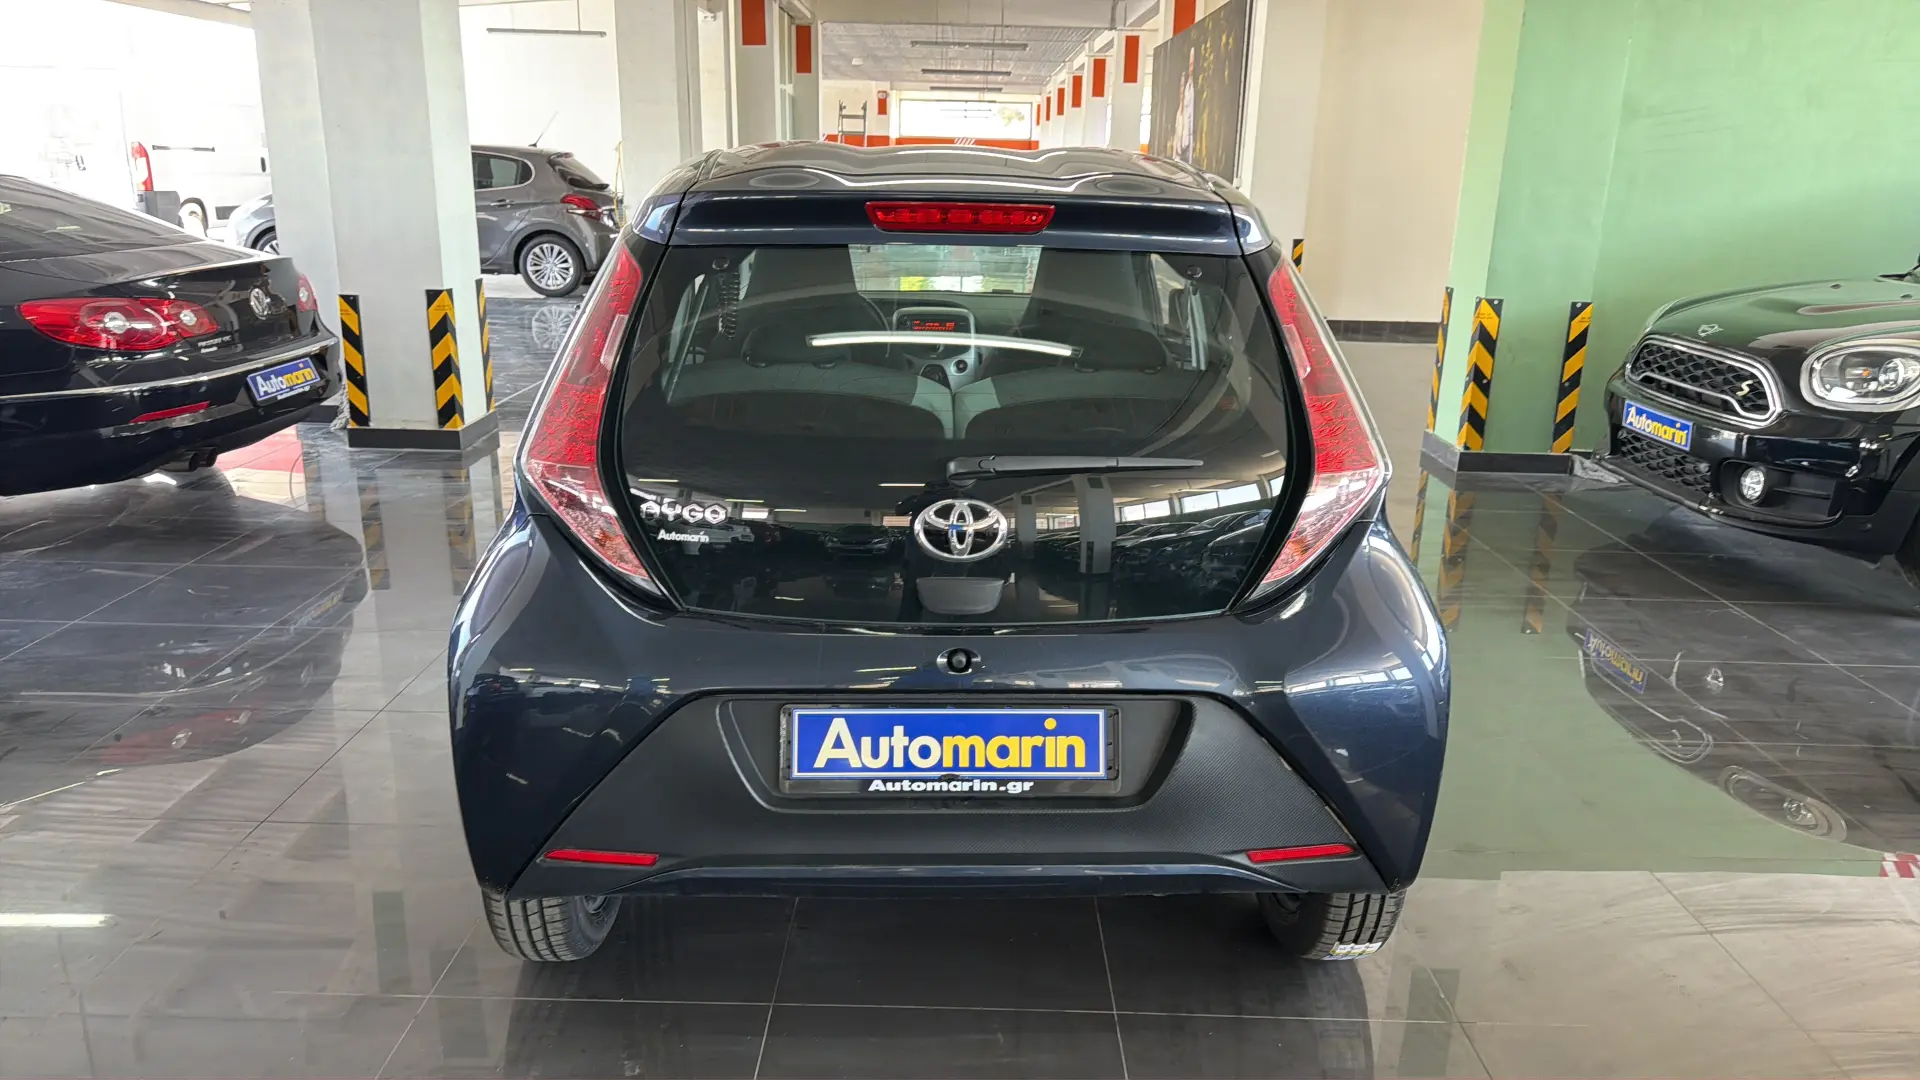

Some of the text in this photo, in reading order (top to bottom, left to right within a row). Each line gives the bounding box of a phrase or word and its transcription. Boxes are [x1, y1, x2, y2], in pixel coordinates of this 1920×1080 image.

[1626, 406, 1688, 446] Automarin
[640, 500, 727, 525] AYGO
[657, 529, 710, 543] Automarin
[813, 717, 1086, 768] Automarin
[868, 779, 1034, 794] Automarin.gr
